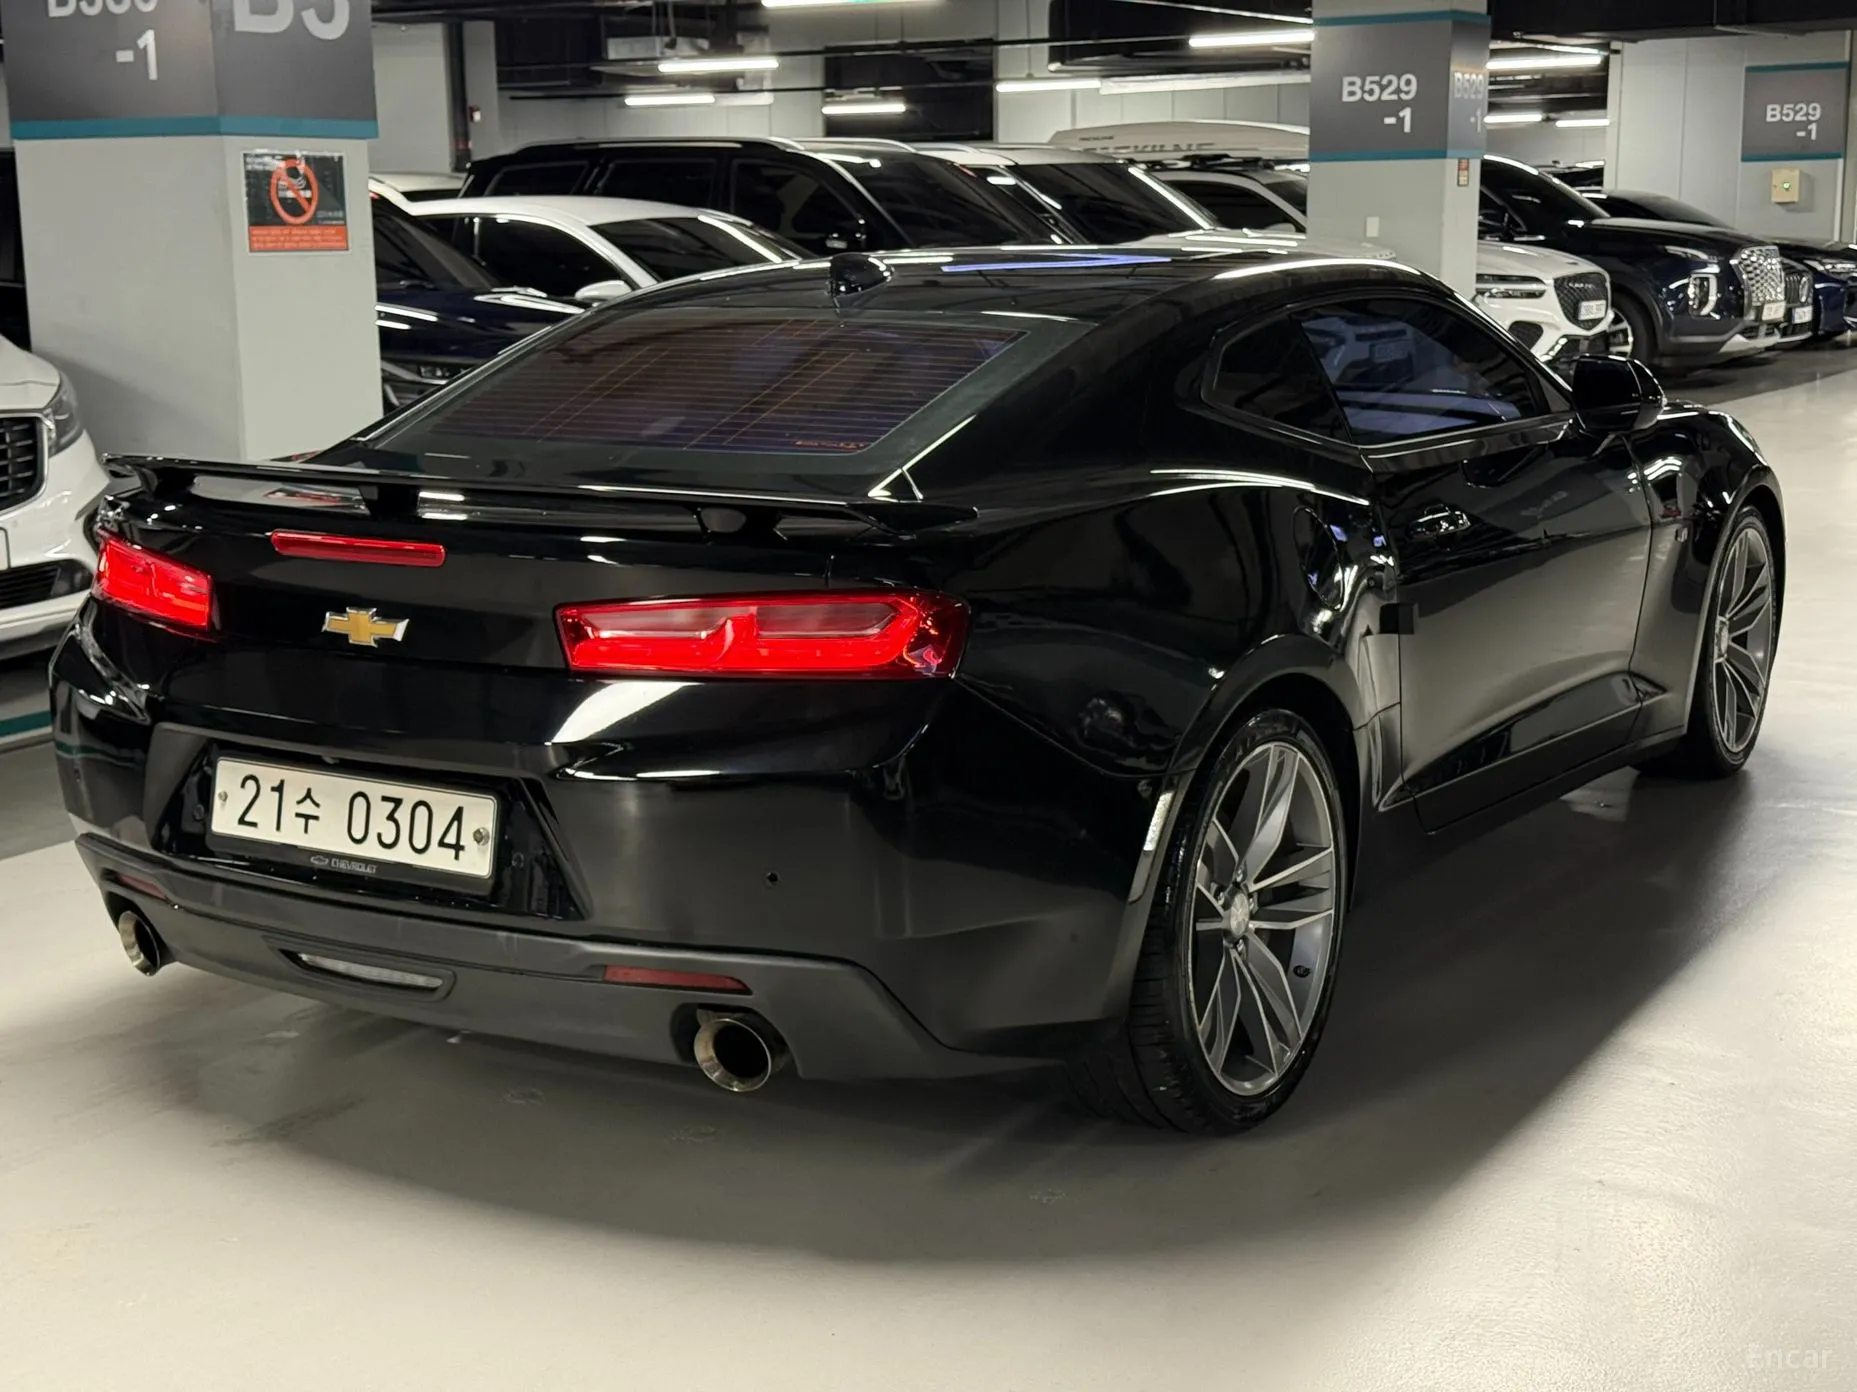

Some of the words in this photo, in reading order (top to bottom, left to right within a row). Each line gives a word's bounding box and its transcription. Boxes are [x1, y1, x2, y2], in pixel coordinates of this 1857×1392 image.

[116, 29, 158, 80] -1
[1342, 73, 1417, 102] B529
[1454, 72, 1485, 98] B529
[1384, 107, 1412, 133] -1
[1470, 108, 1482, 133] -1
[1766, 103, 1821, 122] B529
[1796, 122, 1818, 140] -1
[237, 774, 321, 834] 21수
[347, 791, 466, 861] 0304
[331, 858, 378, 874] CHEVROLET
